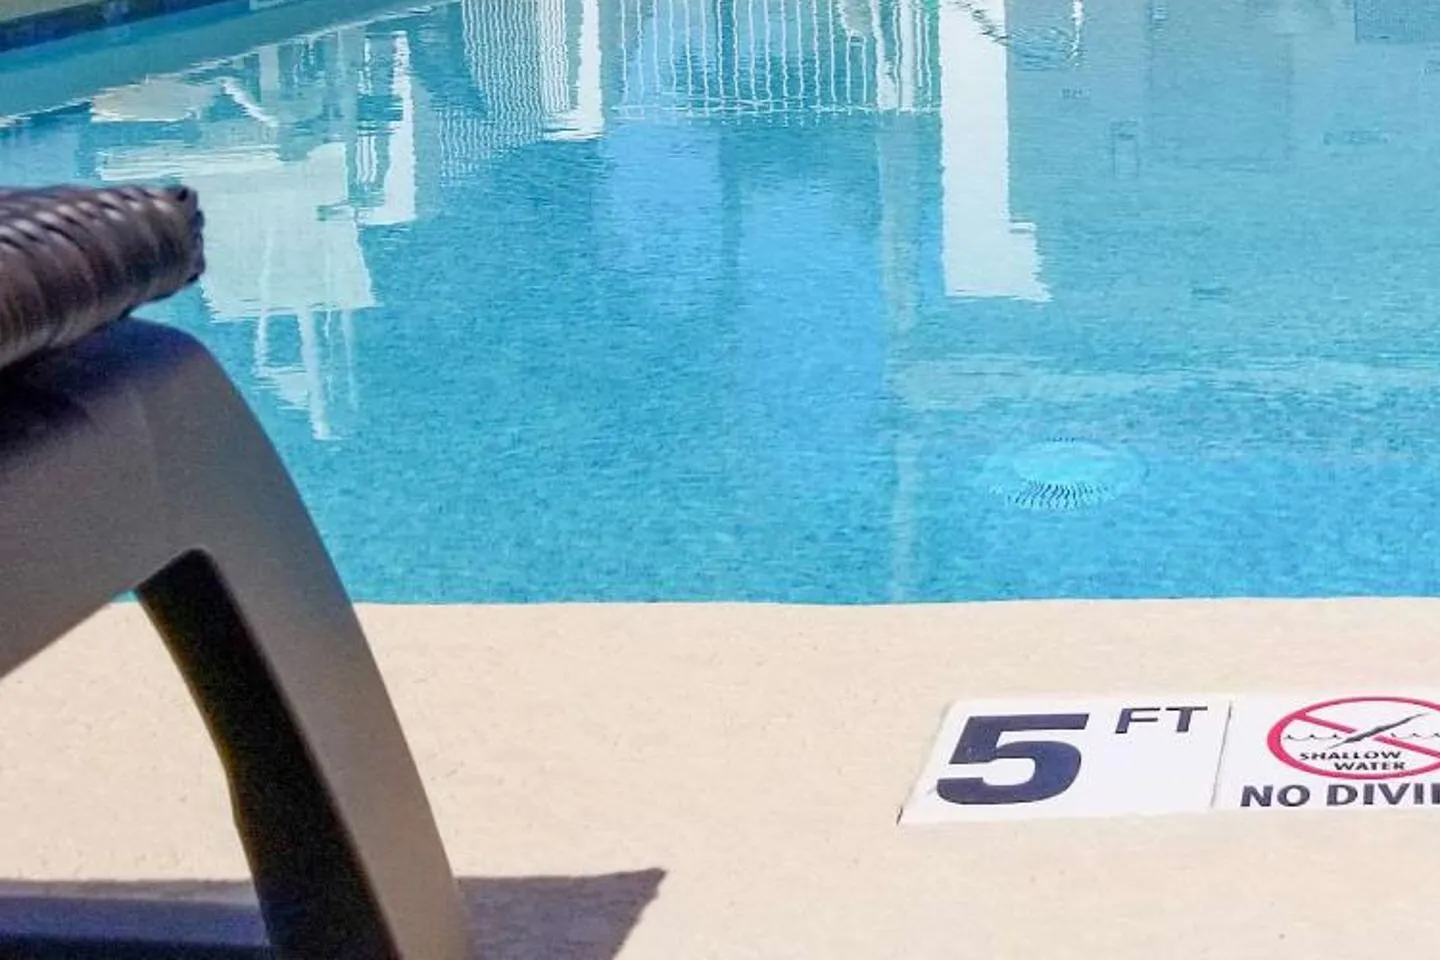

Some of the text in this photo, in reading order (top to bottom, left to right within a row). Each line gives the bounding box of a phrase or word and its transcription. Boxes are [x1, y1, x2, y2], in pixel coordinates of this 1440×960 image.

[936, 706, 1208, 805] 5 FT
[1299, 750, 1402, 760] SHALLOW
[1333, 761, 1406, 771] WATER
[1240, 784, 1310, 807] NO
